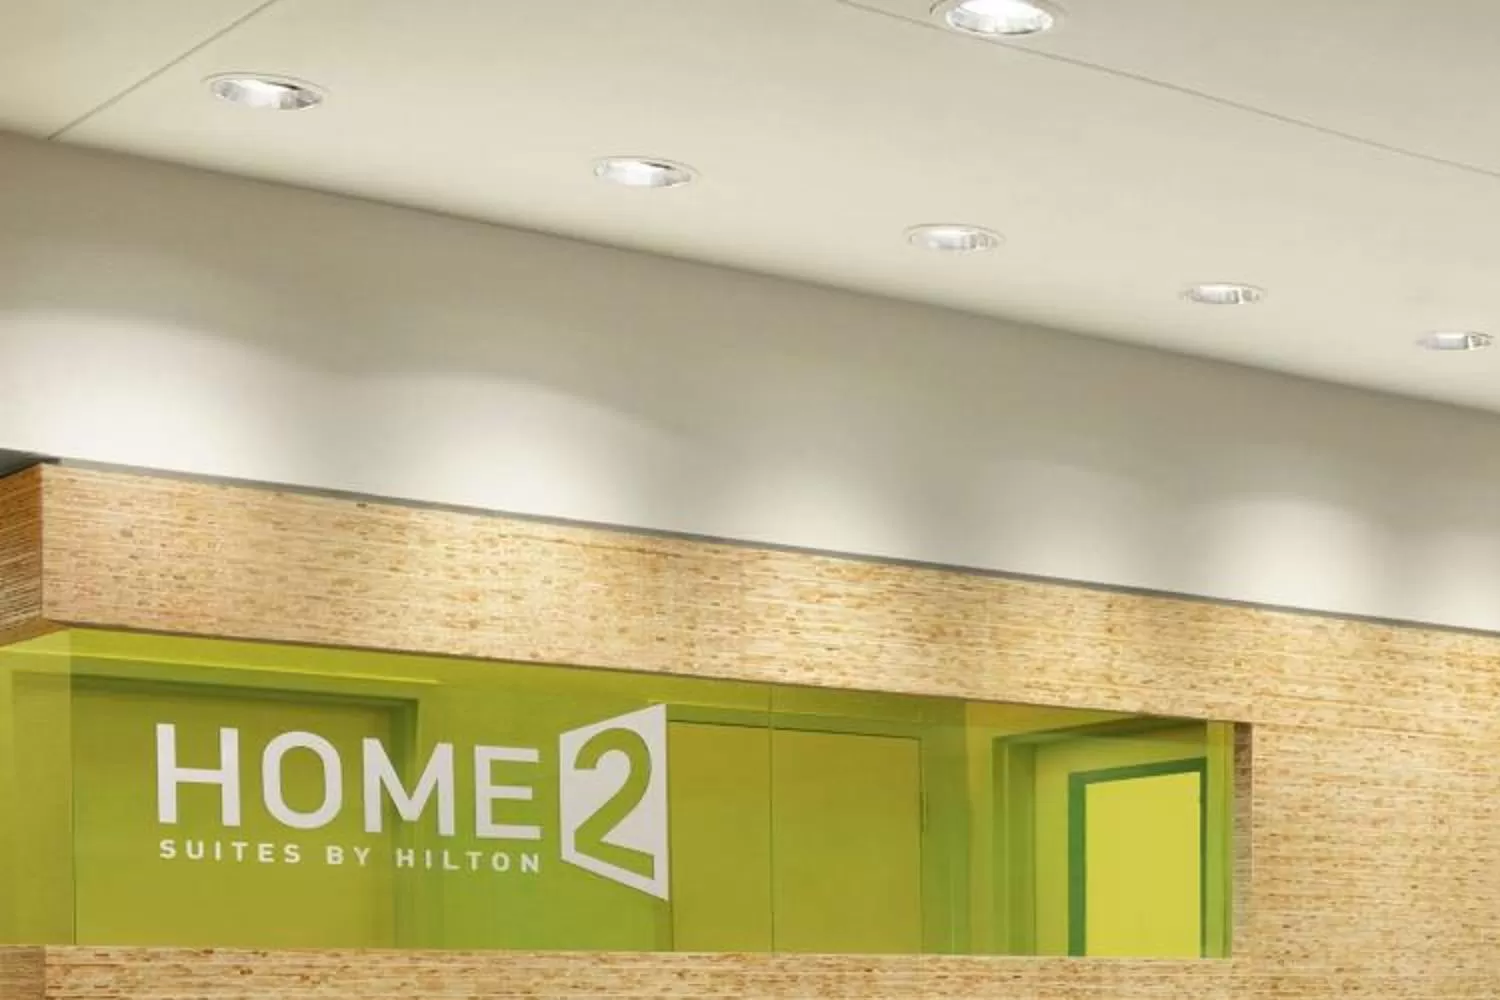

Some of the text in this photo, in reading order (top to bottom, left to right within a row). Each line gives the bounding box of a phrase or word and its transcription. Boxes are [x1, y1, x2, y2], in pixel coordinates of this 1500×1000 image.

[159, 838, 540, 874] SUITES BY HILTON
